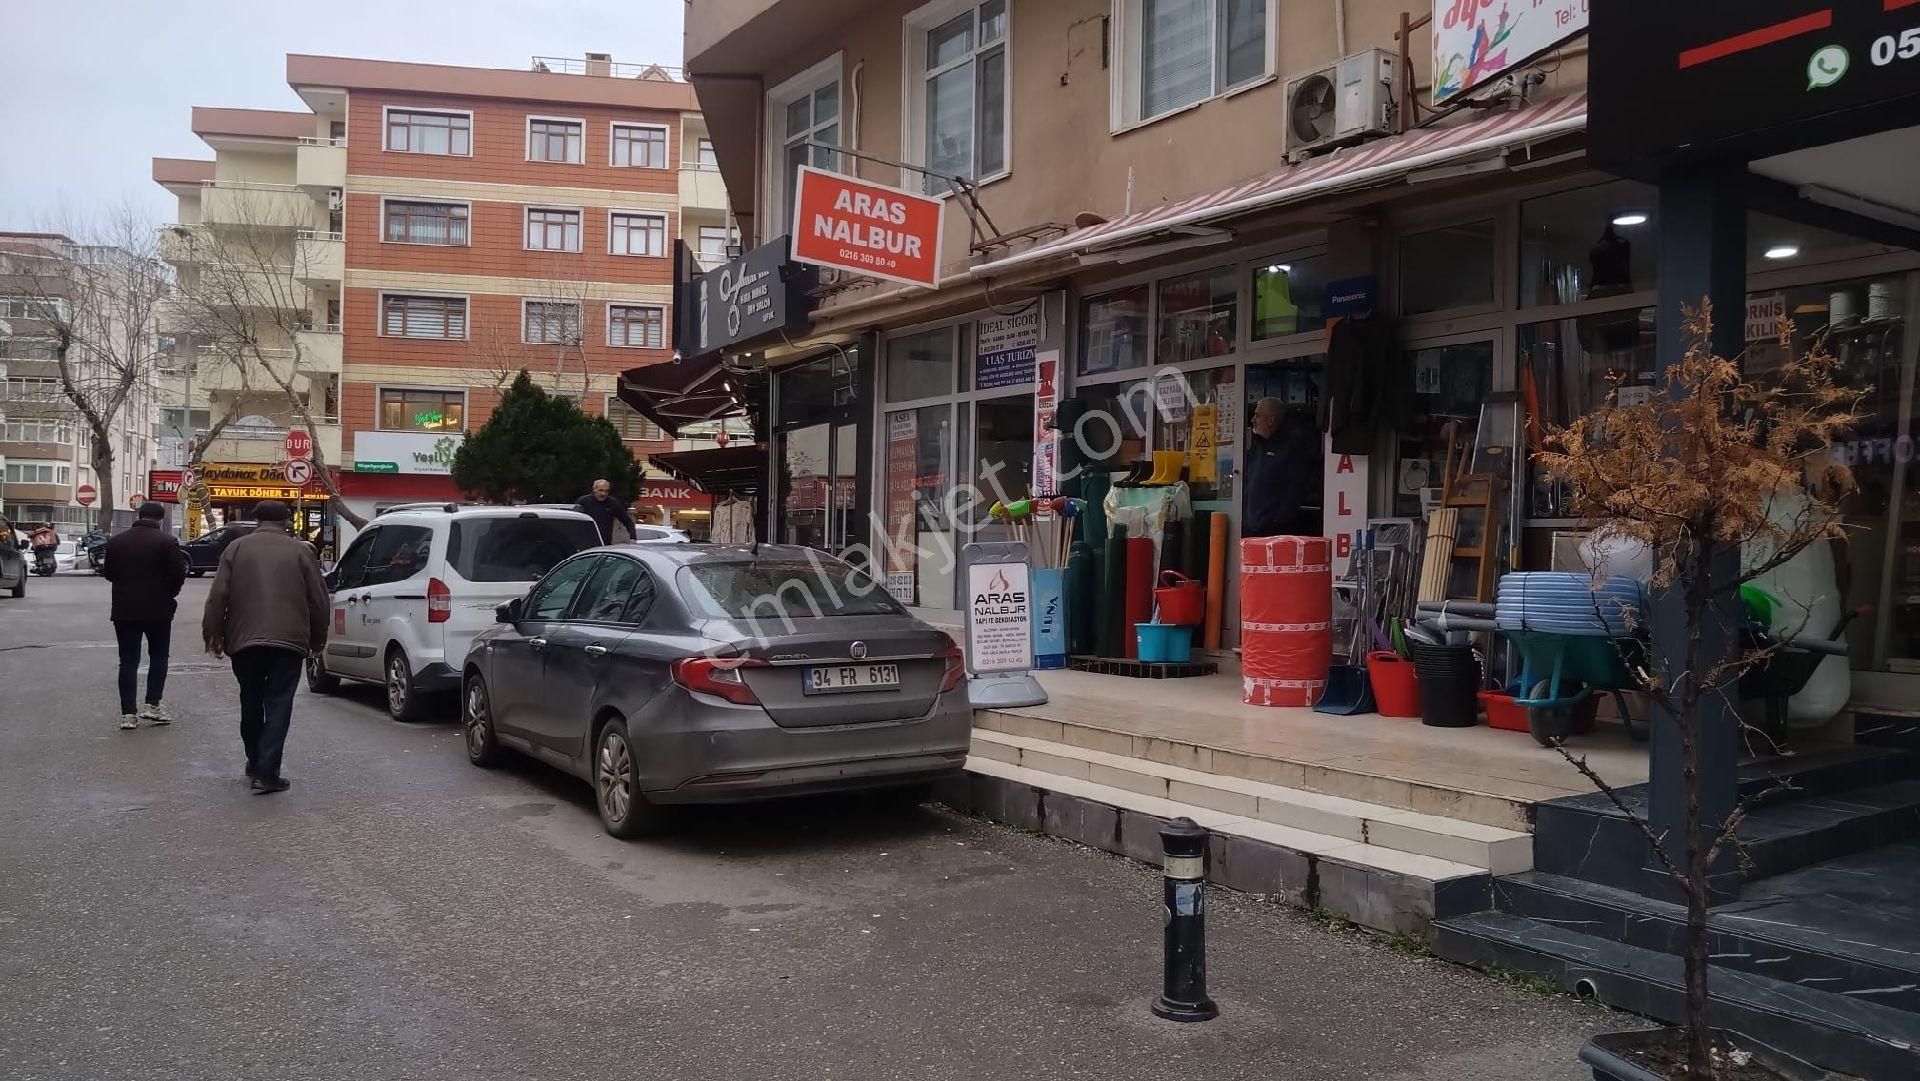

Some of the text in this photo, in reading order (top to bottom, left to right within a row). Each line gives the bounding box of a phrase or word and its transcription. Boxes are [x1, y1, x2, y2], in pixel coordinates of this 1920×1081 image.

[1555, 6, 1577, 28] Tel:
[834, 188, 906, 225] ARAS
[814, 214, 921, 259] NALBUR
[286, 439, 310, 450] DUR
[214, 488, 247, 497] TAVUK
[249, 487, 282, 498] DÖNER
[974, 592, 1026, 605] ARAS
[813, 665, 898, 688] 34 FR 6131
